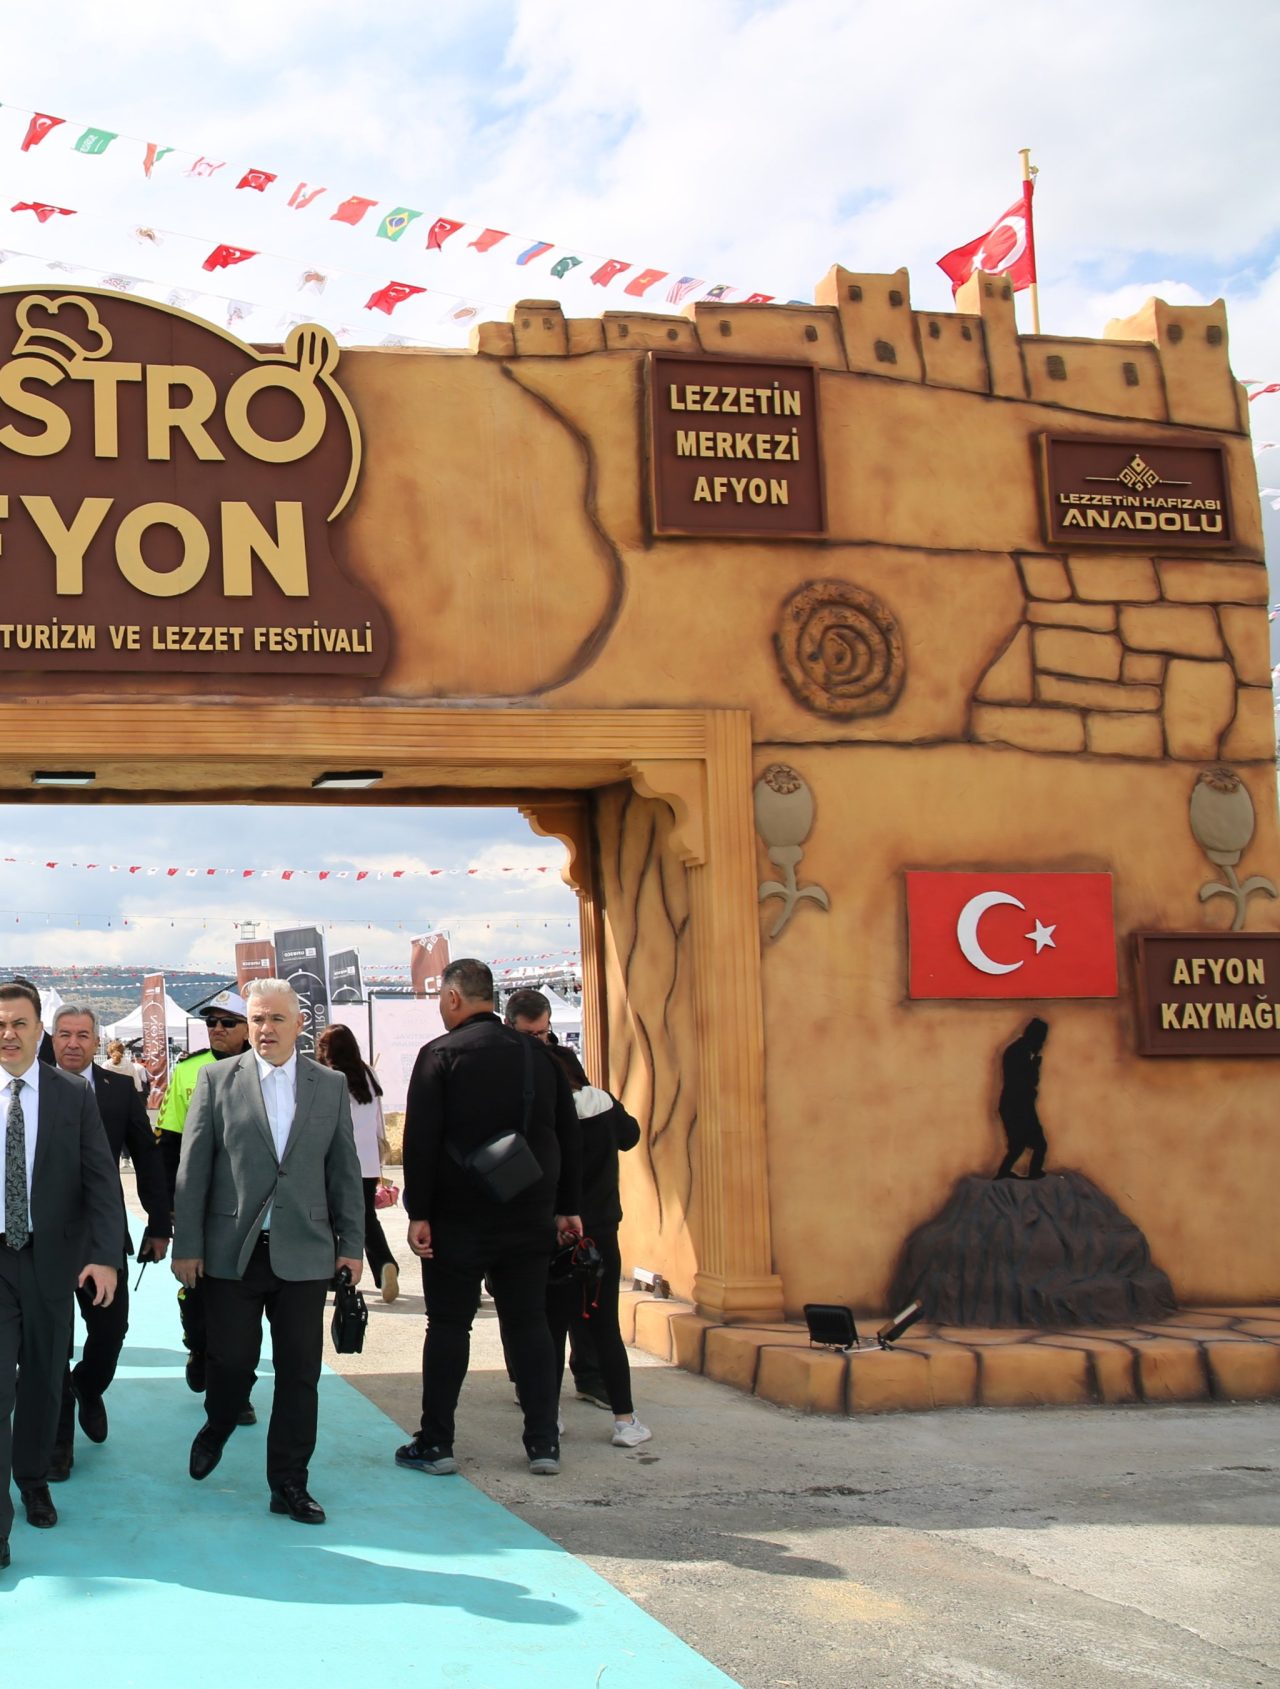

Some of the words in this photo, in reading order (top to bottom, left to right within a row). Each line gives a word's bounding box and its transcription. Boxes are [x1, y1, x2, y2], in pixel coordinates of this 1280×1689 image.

[670, 381, 801, 416] LEZZETİN
[676, 427, 801, 461] MERKEZİ
[693, 476, 789, 505] AFYON
[1143, 497, 1221, 510] HAFIZASI
[1062, 508, 1223, 533] ANADOLU
[0, 617, 97, 651] TURİZM
[110, 626, 141, 651] VE
[152, 627, 244, 652] LEZZET
[254, 620, 374, 654] FESTİVALİ
[1173, 957, 1266, 985] AFYON
